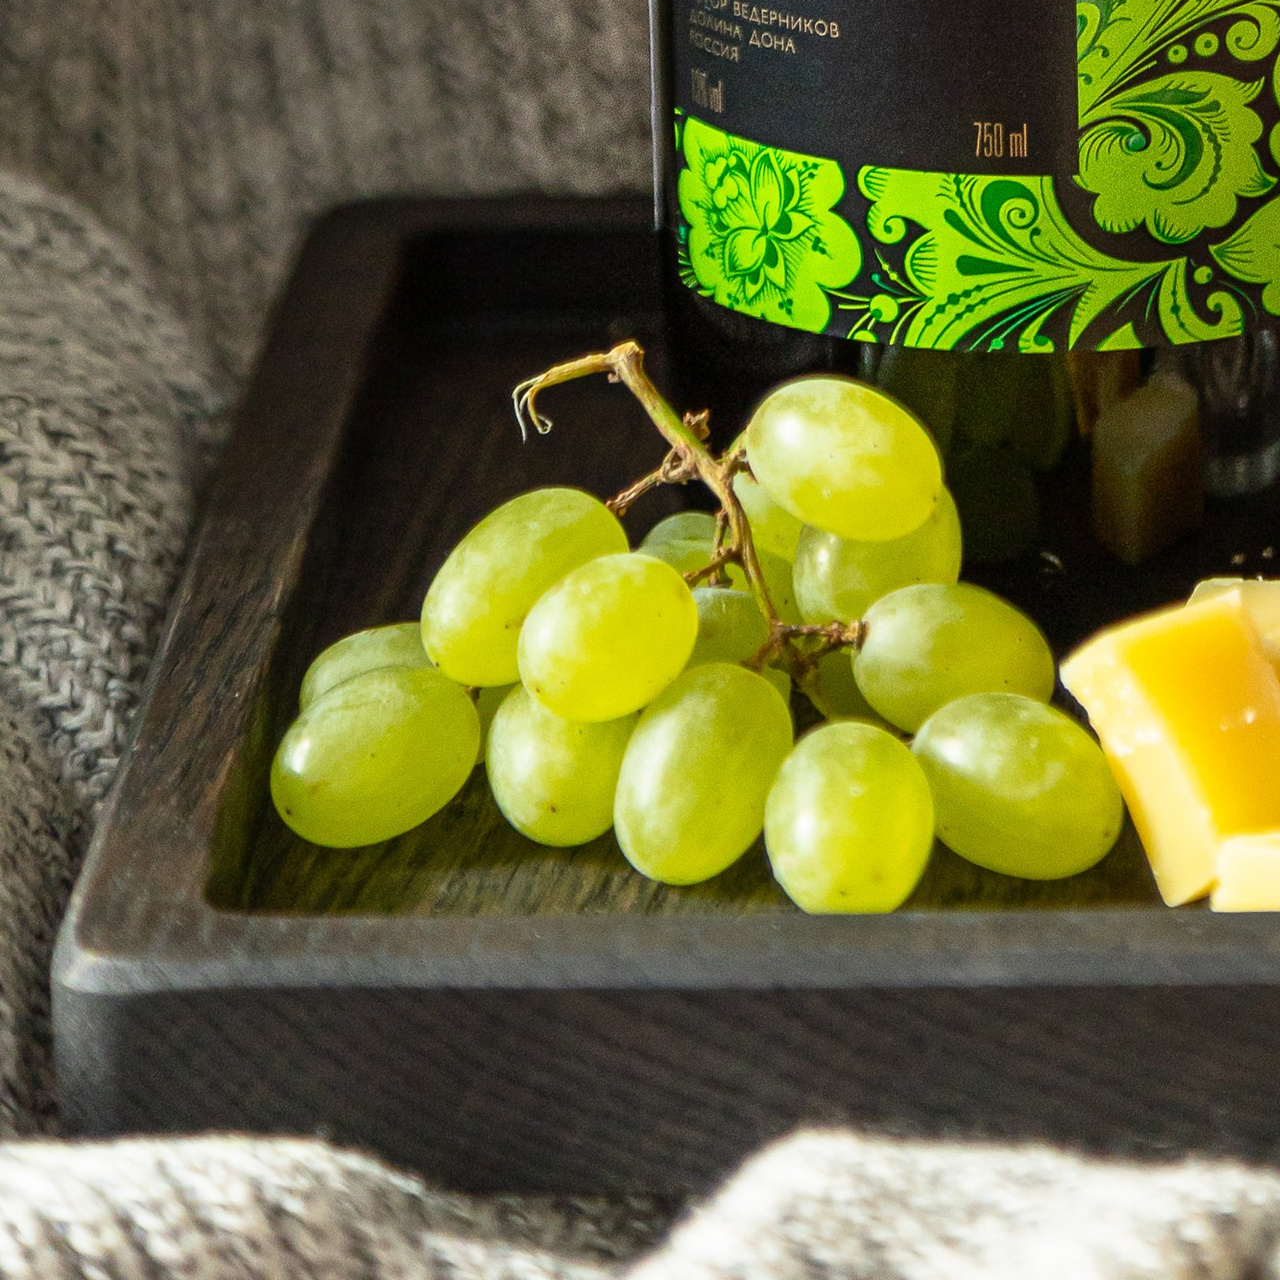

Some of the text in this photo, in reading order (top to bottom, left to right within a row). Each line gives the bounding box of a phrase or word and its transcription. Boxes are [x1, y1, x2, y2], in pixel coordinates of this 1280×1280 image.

[733, 0, 840, 39] ВЕДЕРНИКОВ
[749, 30, 796, 54] ДОНА
[973, 121, 1028, 158] 750 ml
